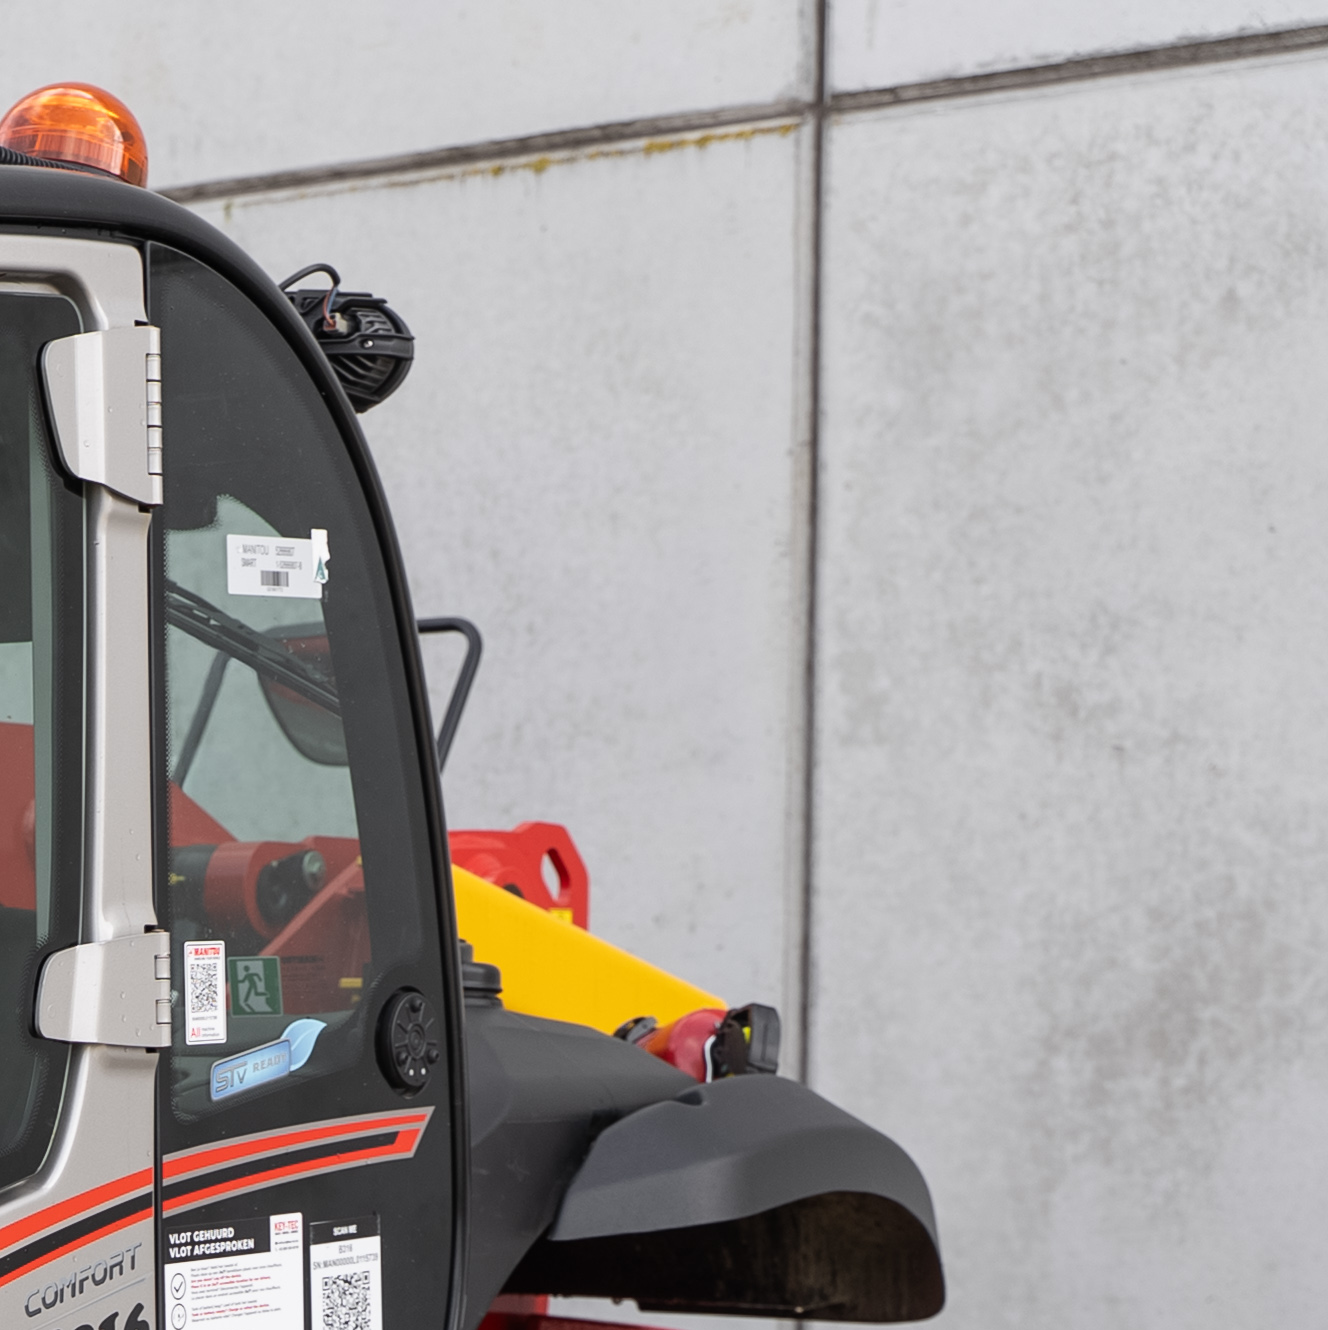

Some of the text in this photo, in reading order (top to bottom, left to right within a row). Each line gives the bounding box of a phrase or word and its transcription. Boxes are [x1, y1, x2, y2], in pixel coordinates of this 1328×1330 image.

[194, 947, 221, 956] MANITOU
[252, 1053, 287, 1073] READY
[274, 1220, 299, 1231] KEY-TEC
[332, 1224, 358, 1237] SCAN ME
[168, 1227, 235, 1245] VLOT GEHUURD
[169, 1238, 255, 1258] VLOT AFGESPROKEN
[24, 1242, 146, 1319] COMFORT
